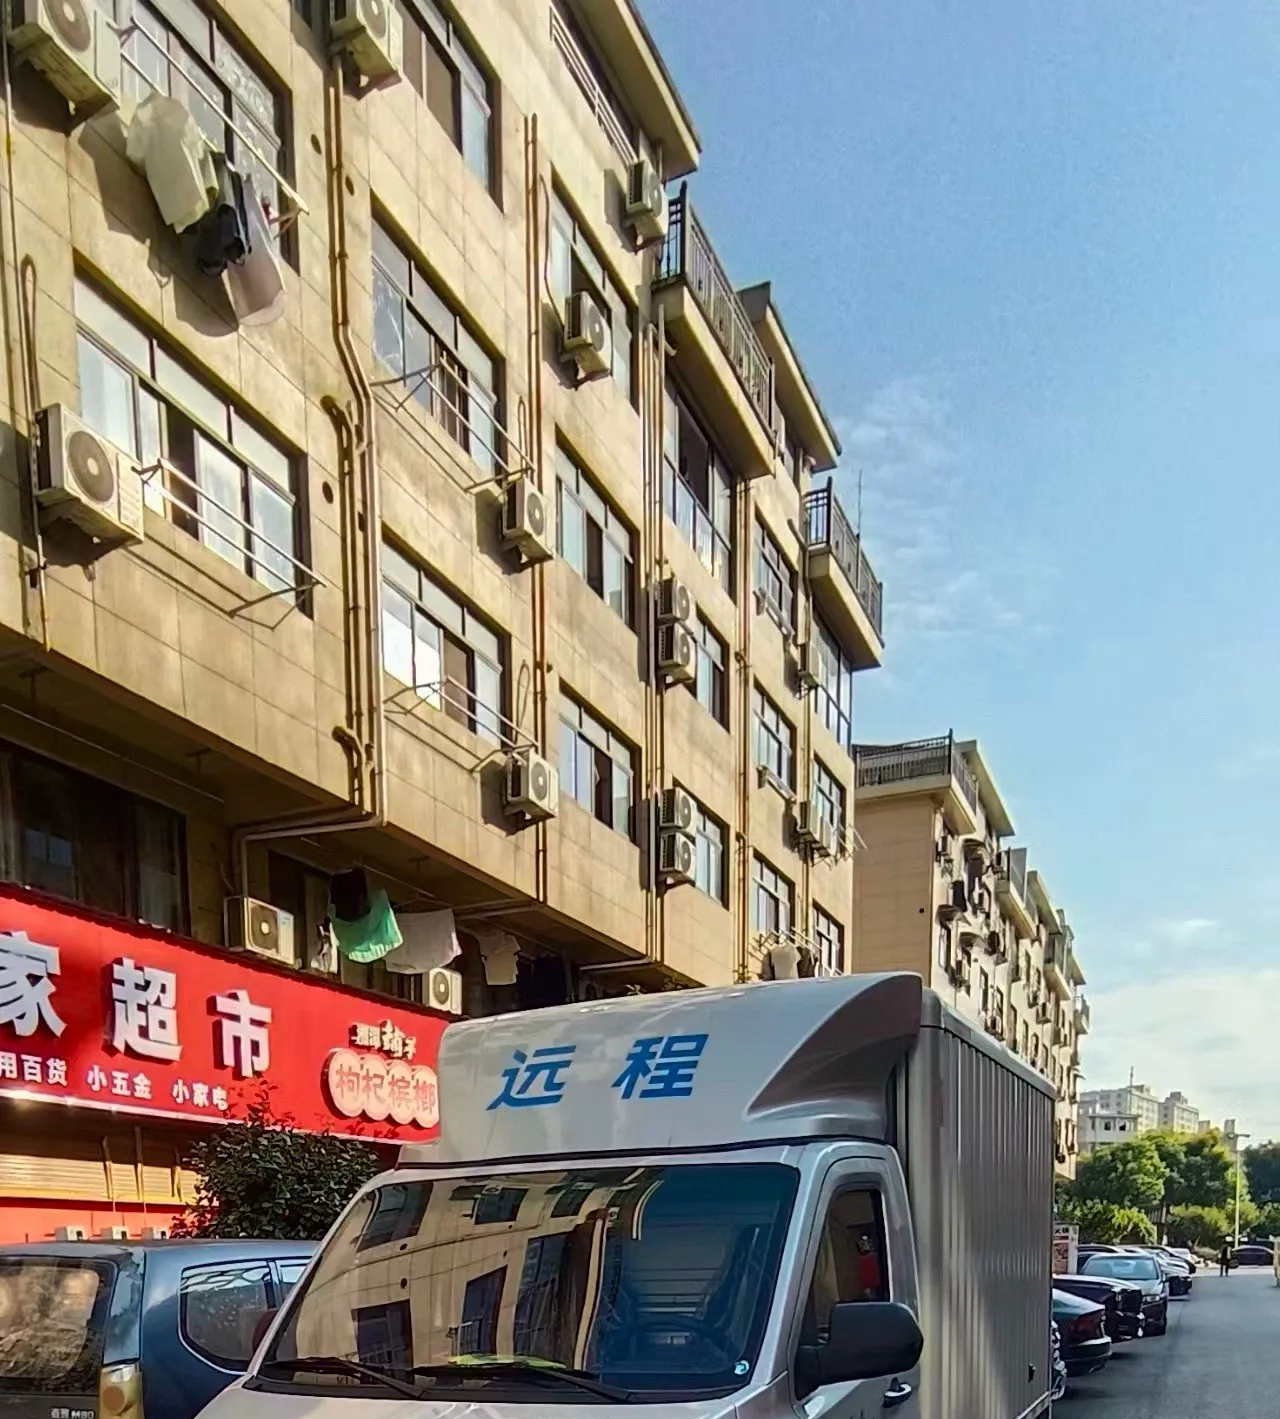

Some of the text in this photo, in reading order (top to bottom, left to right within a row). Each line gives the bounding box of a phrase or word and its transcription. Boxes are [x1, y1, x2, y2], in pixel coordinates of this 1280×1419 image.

[0, 931, 272, 1078] 家超市
[0, 1052, 229, 1111] 用百货 小五金 小家电
[335, 1063, 435, 1114] 枸杞槟榔
[486, 1033, 709, 1111] 远程
